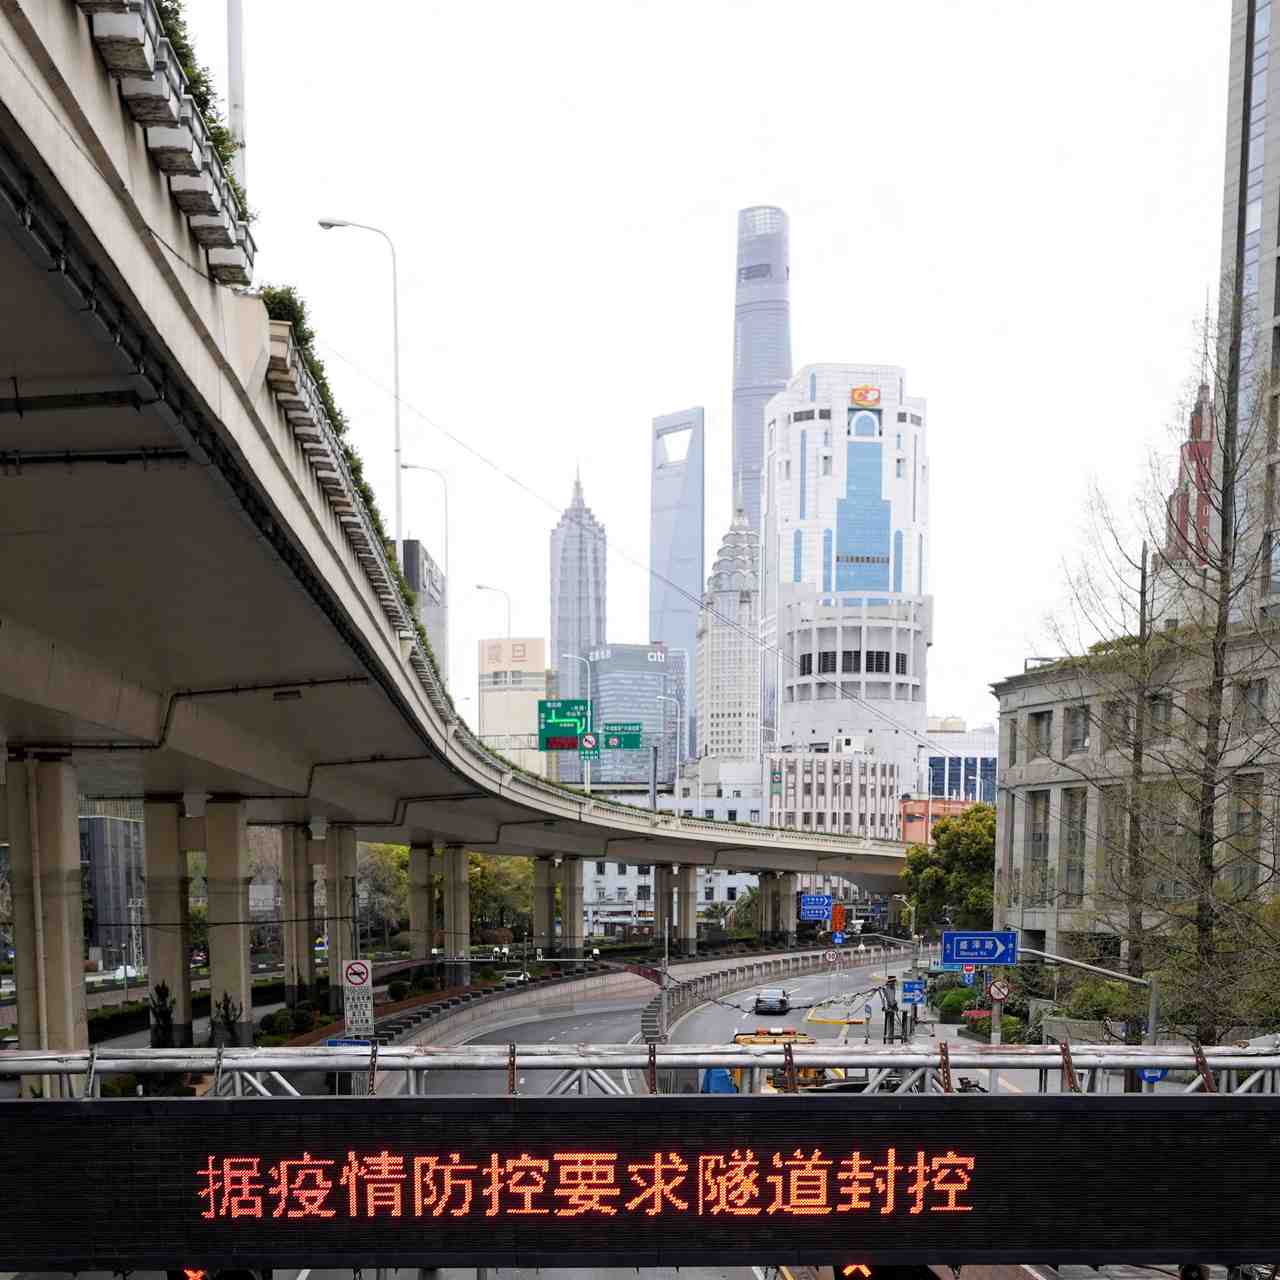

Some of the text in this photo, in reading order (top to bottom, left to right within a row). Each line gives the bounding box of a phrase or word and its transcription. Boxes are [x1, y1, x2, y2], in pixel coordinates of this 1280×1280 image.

[196, 1147, 975, 1218] 据疫情防控要求隧道封控
